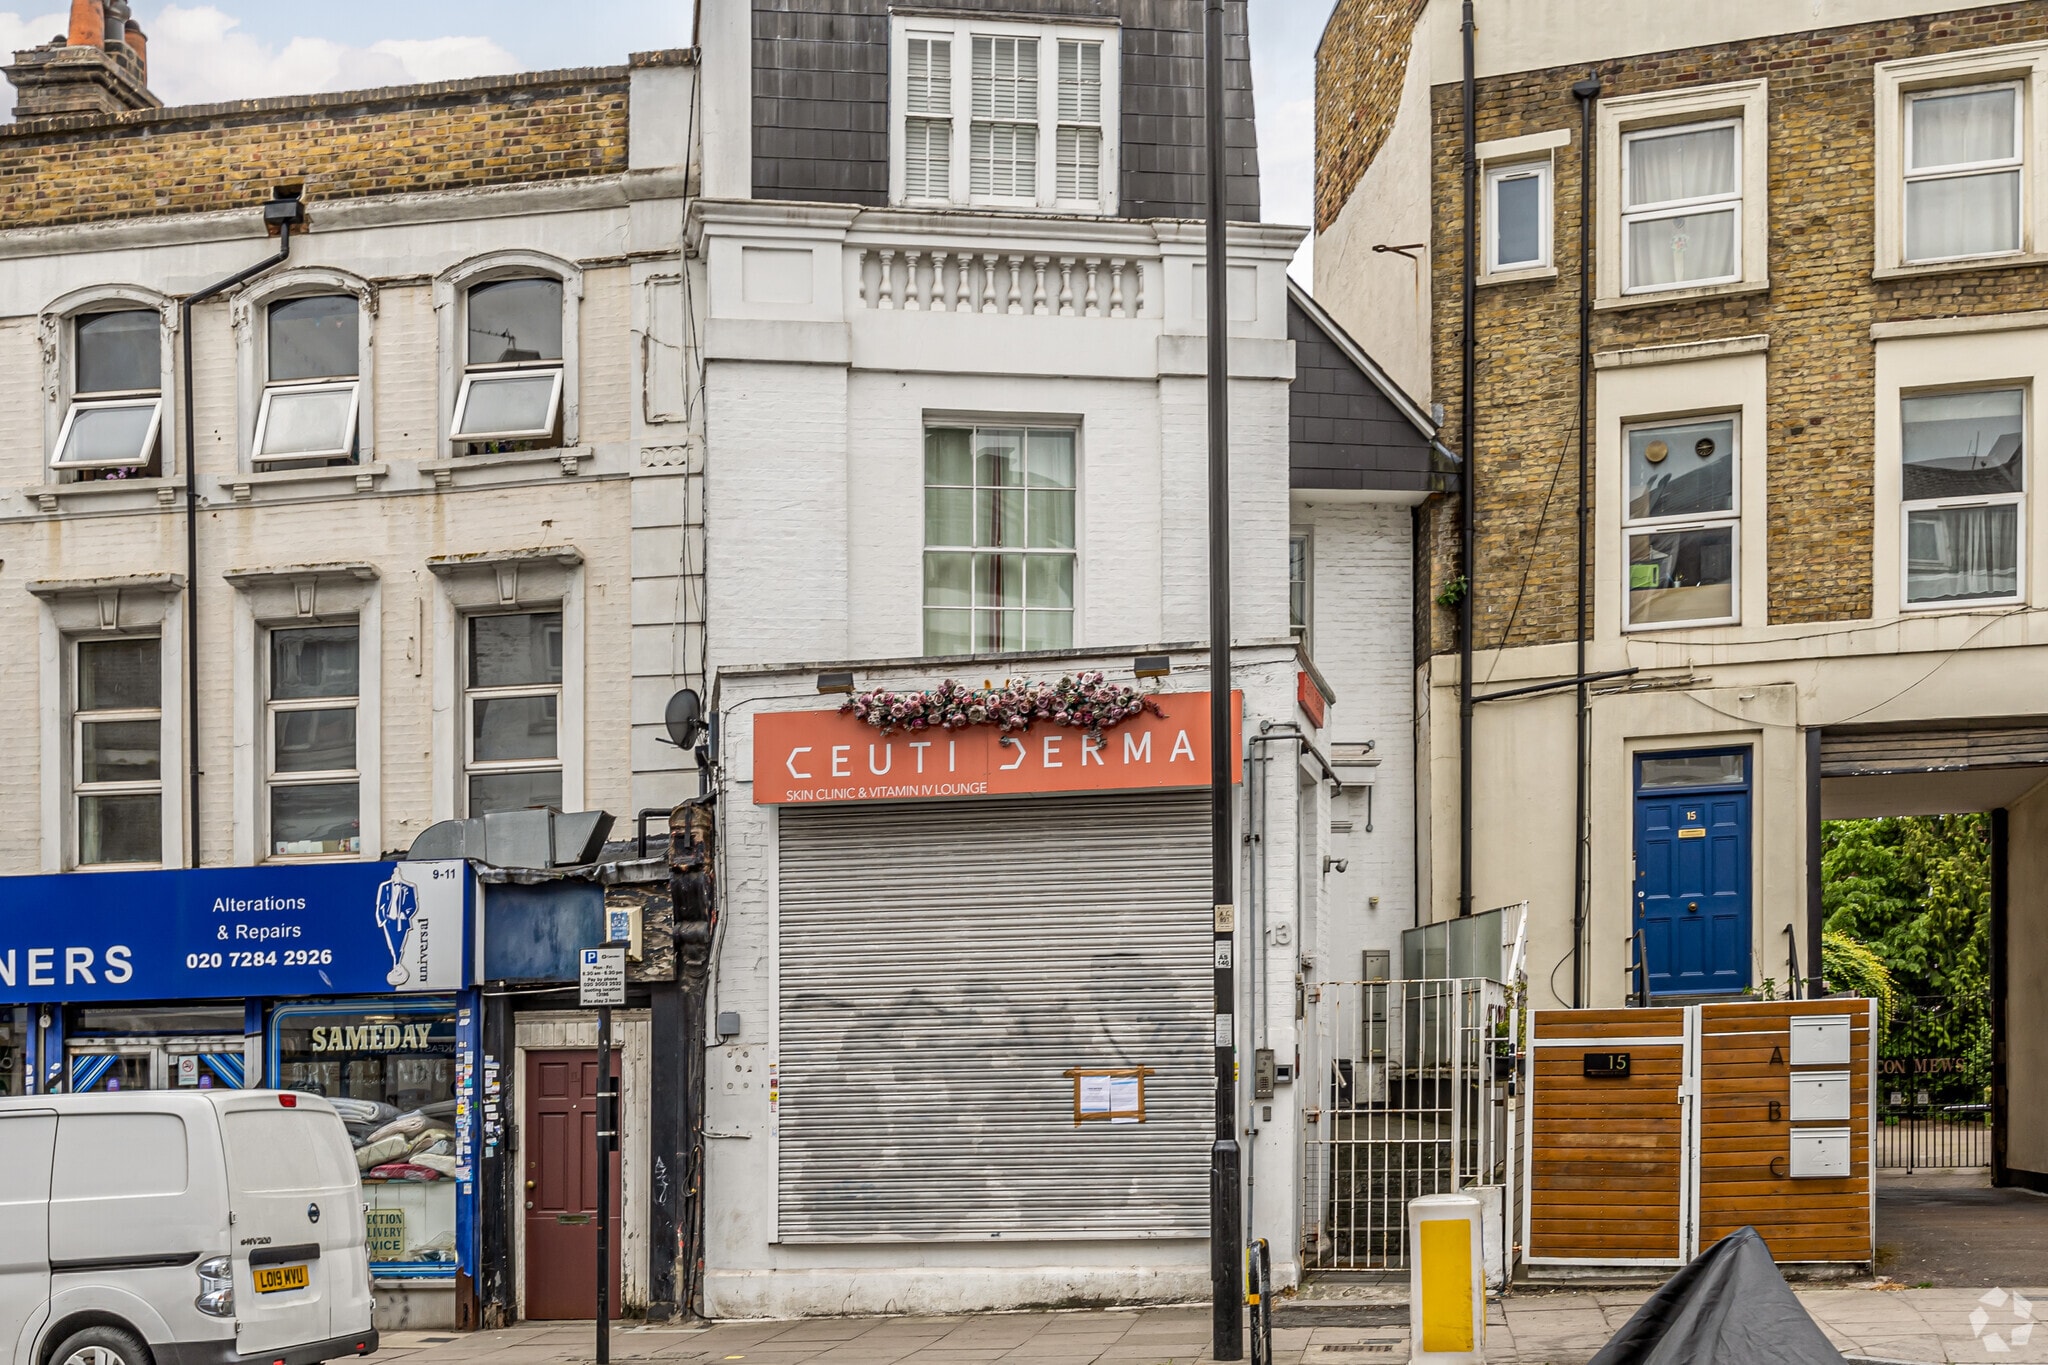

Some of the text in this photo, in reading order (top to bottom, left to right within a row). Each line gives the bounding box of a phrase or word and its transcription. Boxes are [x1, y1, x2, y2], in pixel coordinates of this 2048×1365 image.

[786, 740, 956, 779] CEUTI
[786, 781, 988, 802] SKIN CLINIC & VITAMIN IV LOUNGE
[1686, 811, 1697, 820] 15
[432, 869, 456, 880] 9-11
[212, 896, 306, 912] Alterations
[217, 923, 302, 942] & Repairs
[1265, 921, 1292, 946] 13
[186, 949, 333, 969] 020 7284 2926
[417, 918, 429, 982] universal
[0, 945, 133, 987] NERS
[312, 1023, 432, 1052] SAMEDAY
[1608, 1055, 1627, 1070] 15
[1769, 1046, 1784, 1065] A
[1913, 1058, 1965, 1073] MEWS
[1768, 1100, 1782, 1121] B
[1769, 1156, 1785, 1178] C
[260, 1271, 283, 1288] LO19
